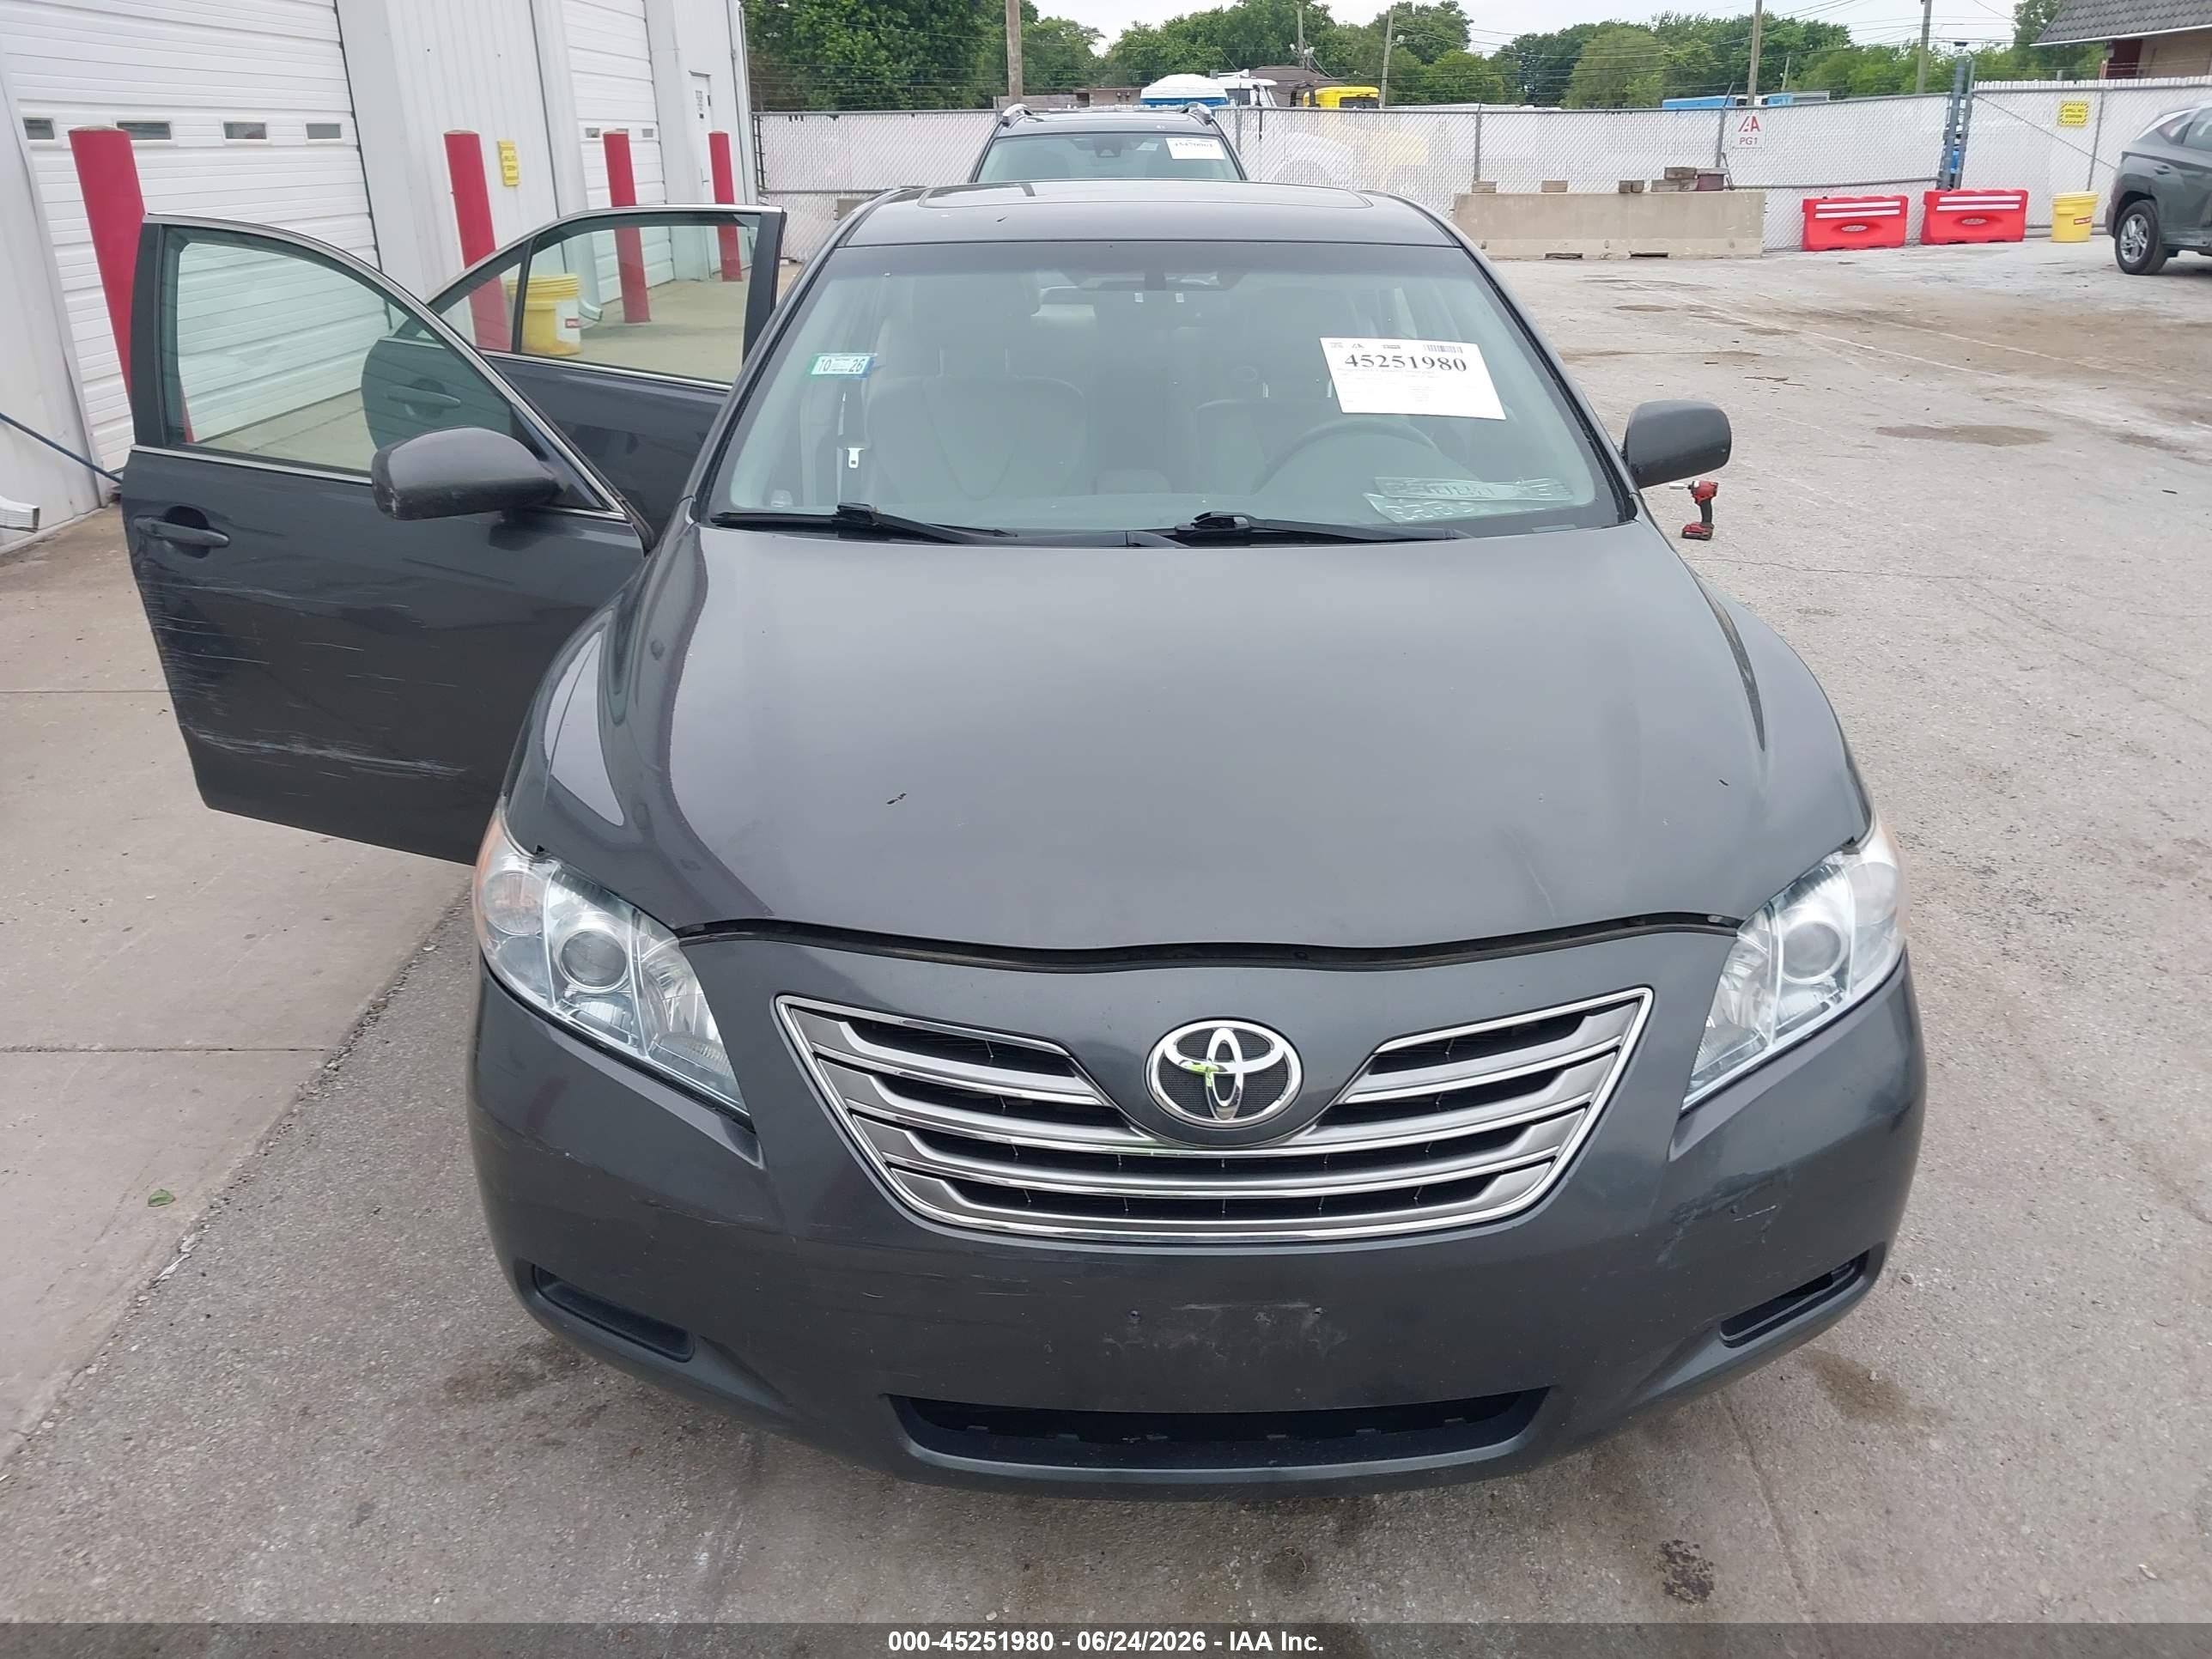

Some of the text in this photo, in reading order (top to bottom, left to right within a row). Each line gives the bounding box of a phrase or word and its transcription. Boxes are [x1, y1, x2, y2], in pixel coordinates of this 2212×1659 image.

[1740, 137, 1758, 145] PG1
[818, 359, 832, 372] 10
[848, 359, 866, 372] 26
[1345, 354, 1468, 372] 45251980
